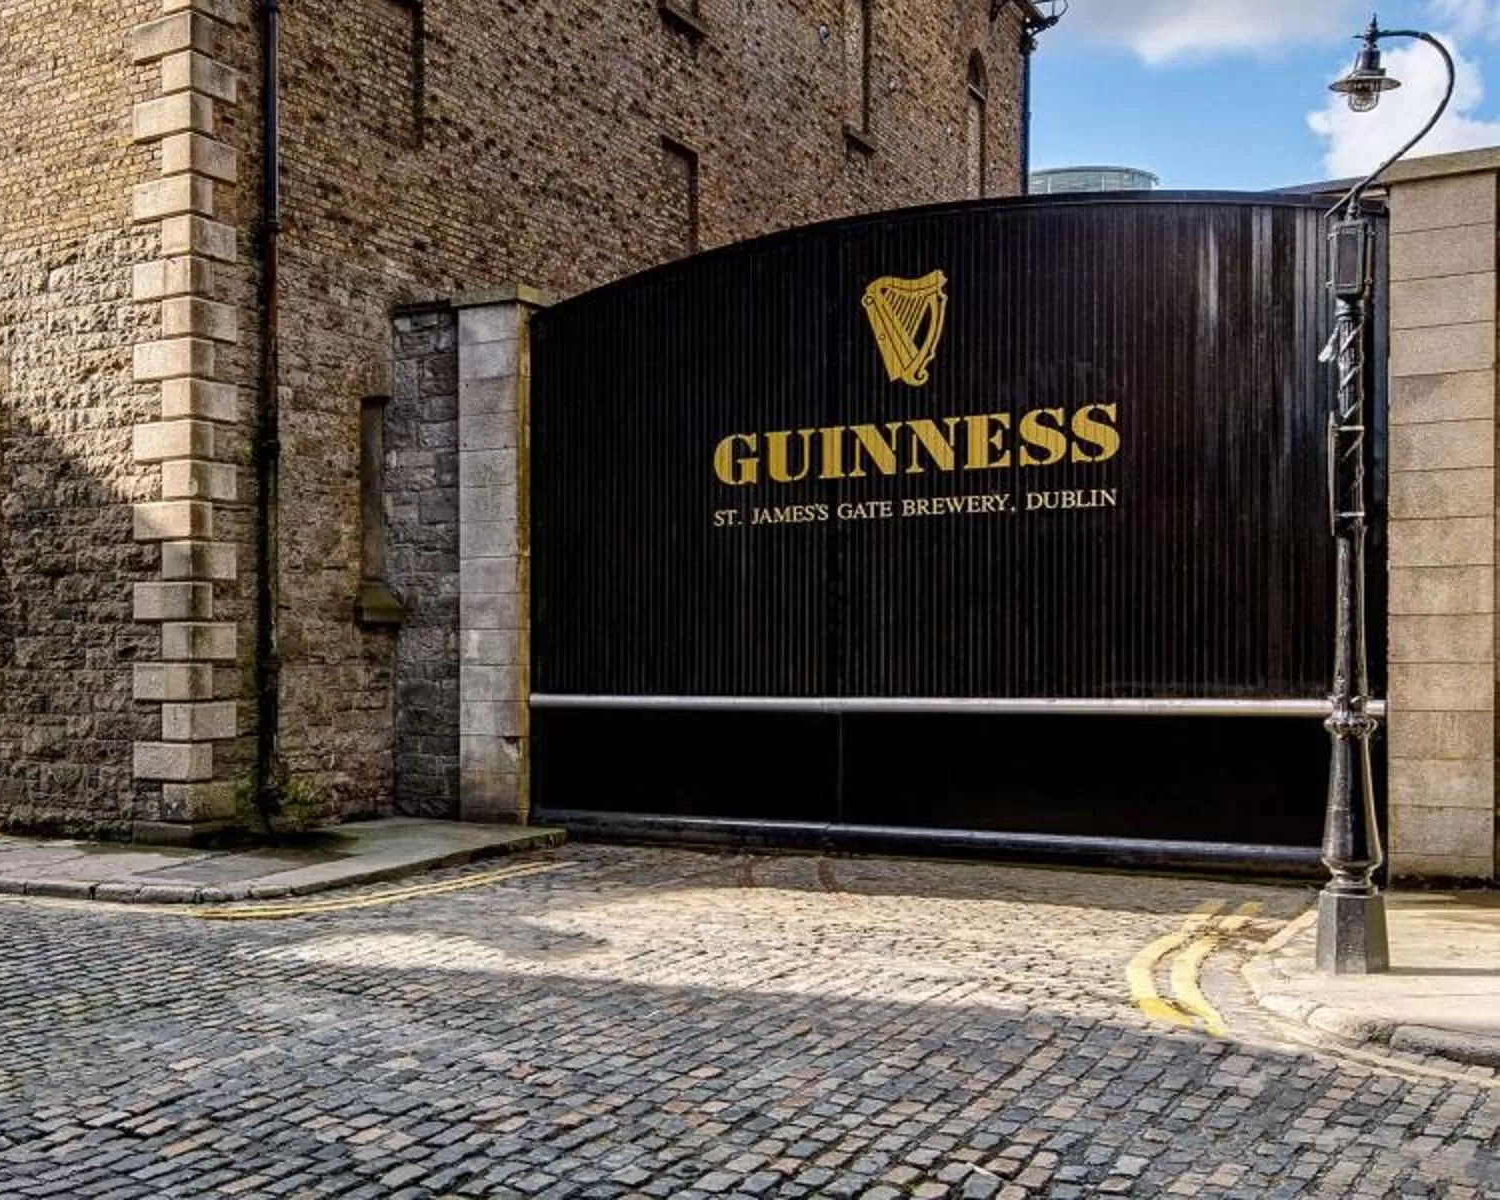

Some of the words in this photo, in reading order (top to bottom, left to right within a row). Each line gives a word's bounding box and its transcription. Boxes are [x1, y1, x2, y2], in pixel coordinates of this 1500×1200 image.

[713, 402, 1121, 486] GUINNESS
[713, 509, 744, 527] ST.
[751, 503, 829, 525] JAMES'S
[837, 501, 893, 520] GATE
[901, 493, 1016, 517] BREWERY,
[1025, 488, 1117, 510] DUBLIN
